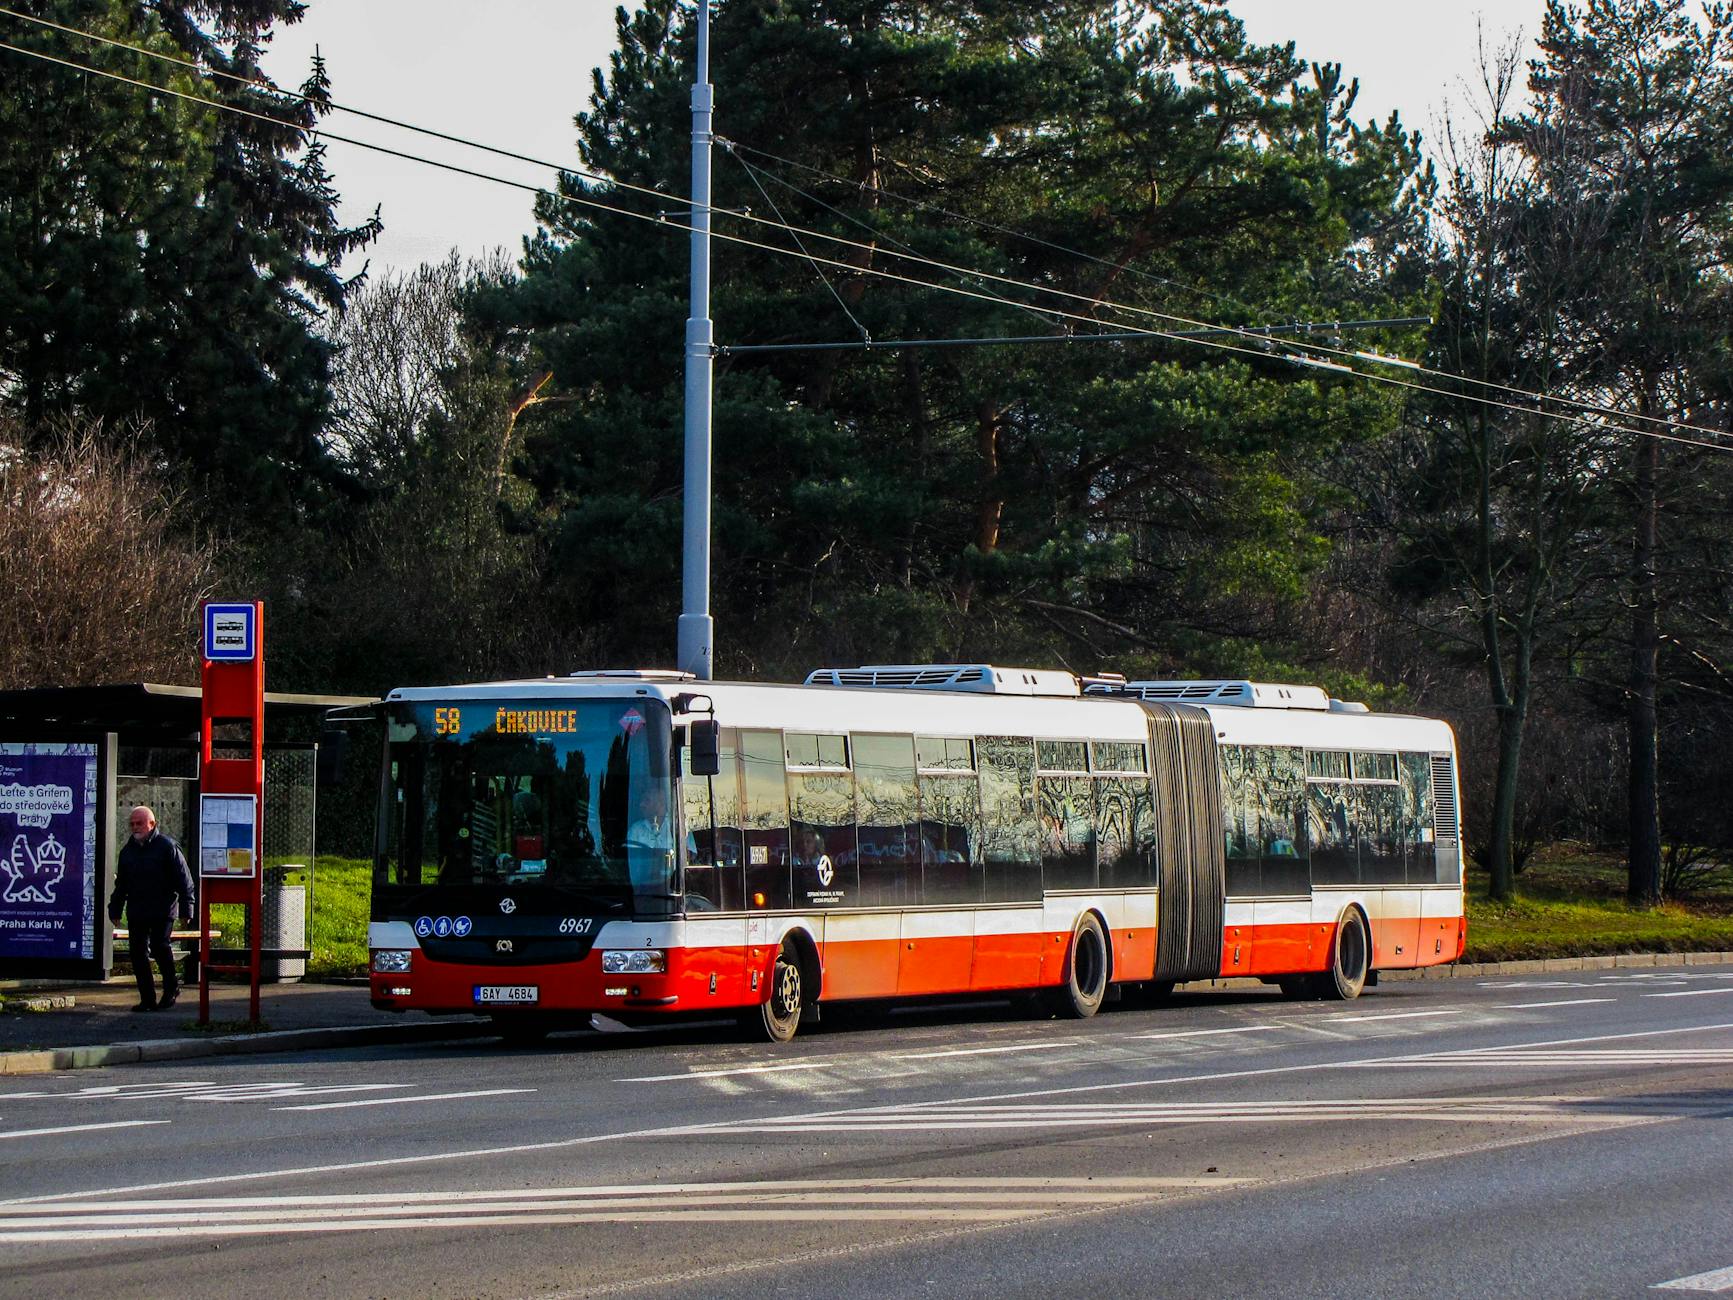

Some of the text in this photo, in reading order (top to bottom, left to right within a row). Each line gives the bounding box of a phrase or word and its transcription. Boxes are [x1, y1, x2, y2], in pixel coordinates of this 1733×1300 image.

[435, 707, 577, 734] 58 ČAKOVICE
[29, 789, 34, 797] s
[36, 787, 70, 798] Grifem
[0, 800, 70, 810] do středověké
[20, 815, 49, 826] Prahy
[752, 848, 767, 862] 6967
[0, 920, 65, 929] Praha Karla IV.
[559, 918, 593, 933] 6967
[646, 938, 652, 947] 2
[482, 988, 501, 1000] 6AY
[508, 988, 533, 1000] 4684
